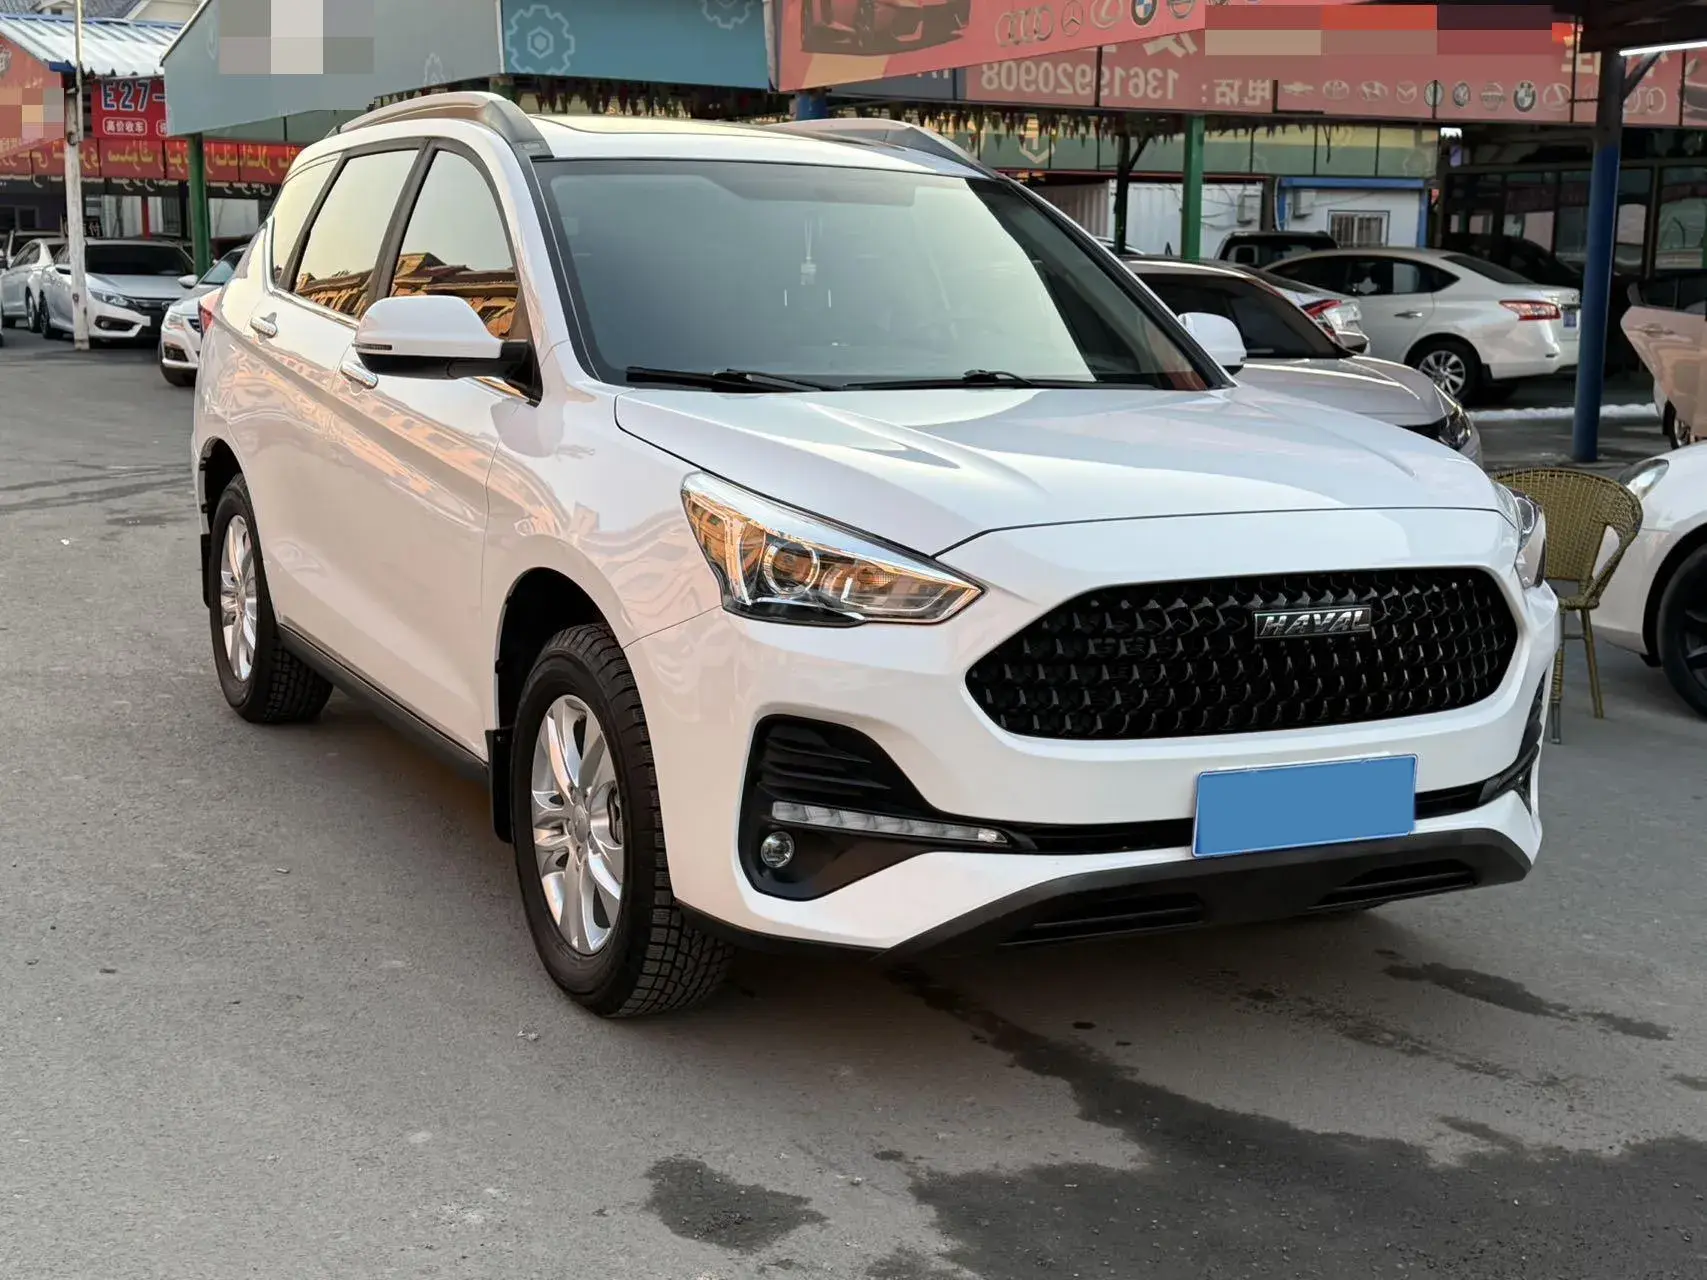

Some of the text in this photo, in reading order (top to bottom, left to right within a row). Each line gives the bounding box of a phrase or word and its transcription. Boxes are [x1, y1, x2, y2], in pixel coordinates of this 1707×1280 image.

[106, 119, 145, 133] 高价收车
[1260, 611, 1370, 636] HAVAL
